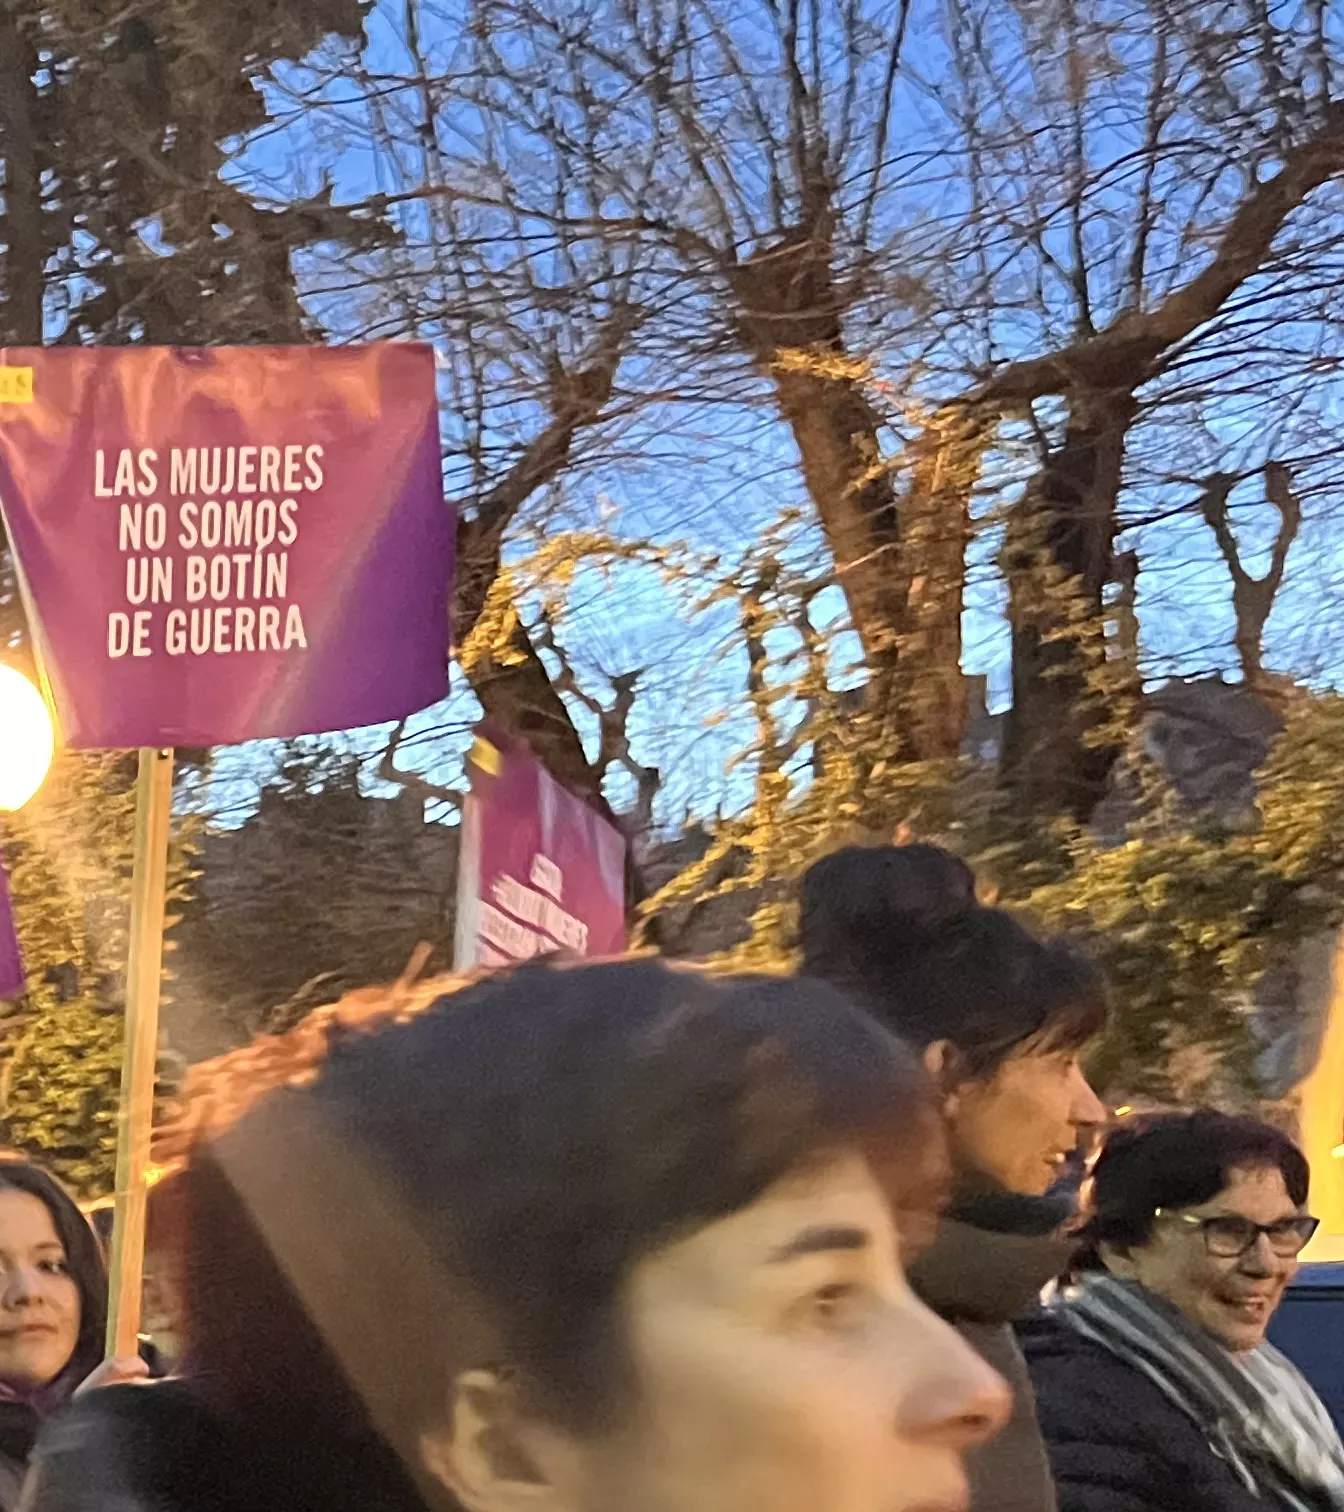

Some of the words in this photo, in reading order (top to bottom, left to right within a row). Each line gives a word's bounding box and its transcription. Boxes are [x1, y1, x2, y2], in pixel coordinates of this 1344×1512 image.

[95, 448, 158, 498] LAS
[170, 444, 324, 496] MUJERES
[119, 503, 167, 551] NO
[178, 498, 299, 549] SOMOS
[126, 556, 174, 605] UN
[186, 540, 288, 603] BOTÍN
[108, 610, 153, 658] DE
[165, 604, 308, 656] GUERRA
